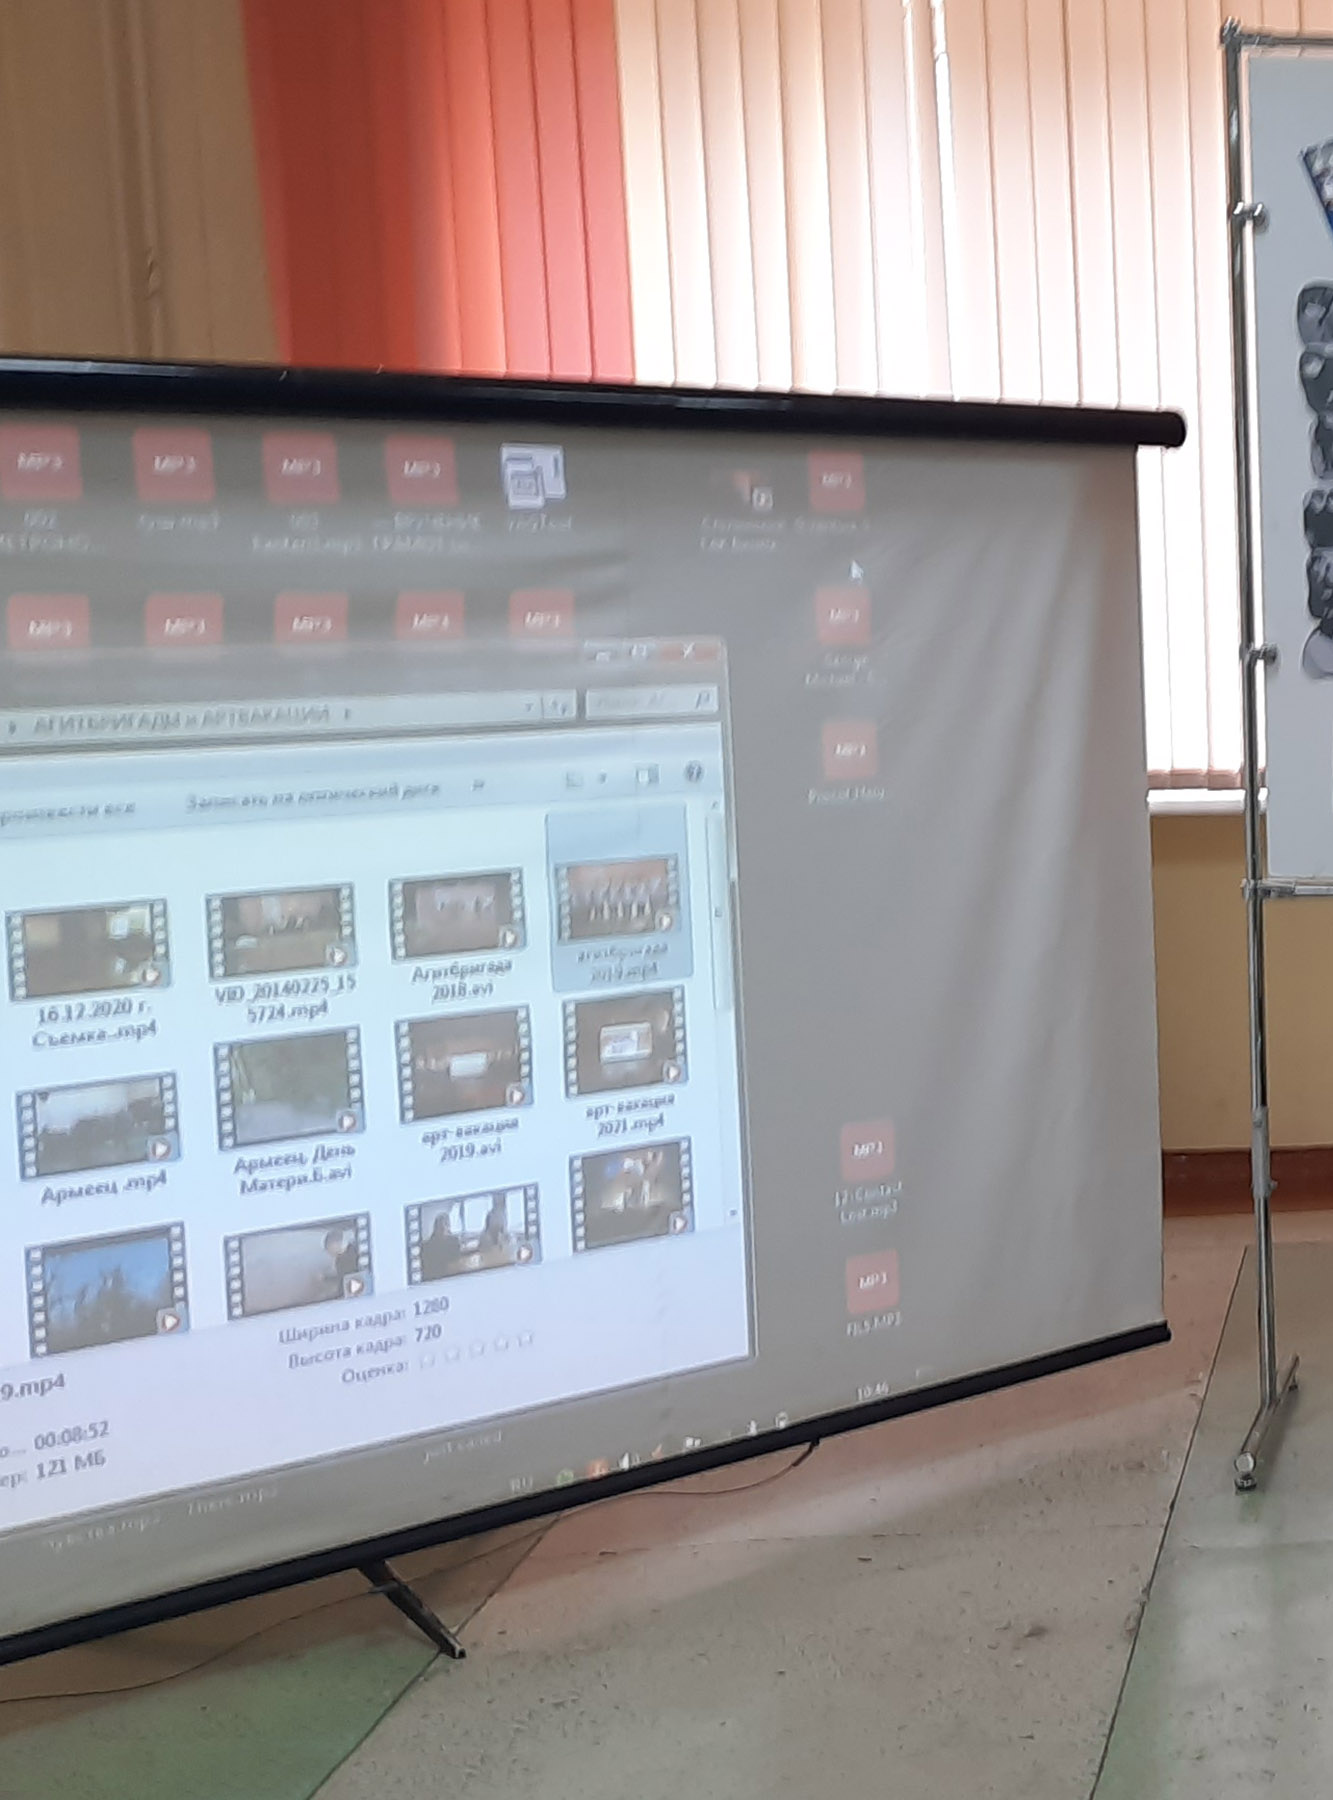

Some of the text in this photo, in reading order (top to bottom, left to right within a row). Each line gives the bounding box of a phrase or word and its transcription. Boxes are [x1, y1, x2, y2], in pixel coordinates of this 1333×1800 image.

[278, 1318, 350, 1344] Ширина
[412, 1295, 450, 1318] 1280
[287, 1344, 352, 1370] Высота
[414, 1322, 443, 1344] 720
[33, 1419, 110, 1451] 00:08:52
[36, 1458, 67, 1480] 121
